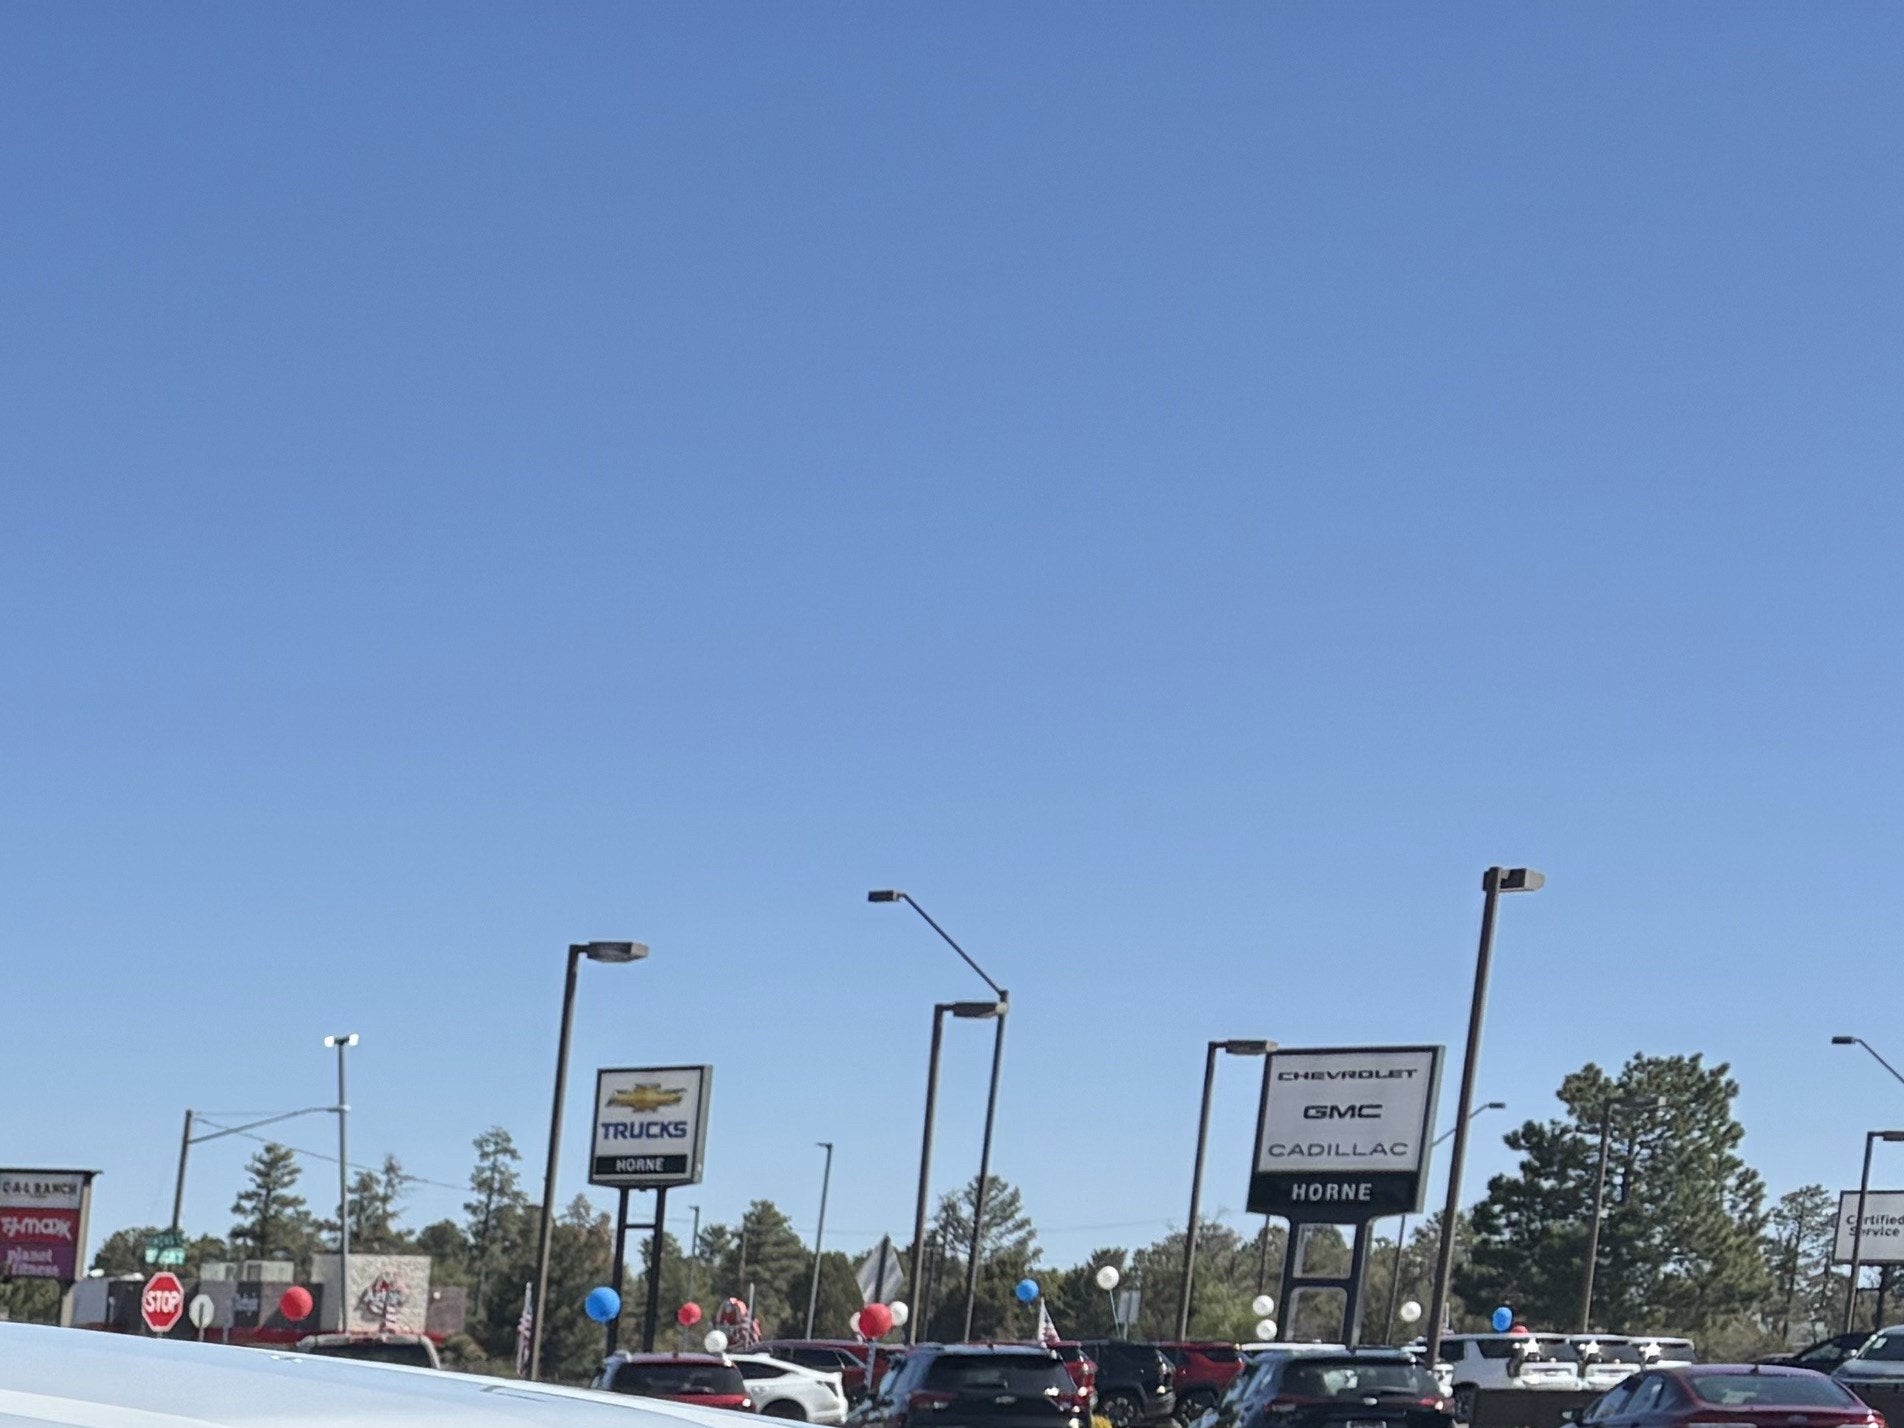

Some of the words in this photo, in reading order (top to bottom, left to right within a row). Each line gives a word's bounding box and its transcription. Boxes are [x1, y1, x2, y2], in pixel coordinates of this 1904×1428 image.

[1277, 1069, 1418, 1082] CHEVROLET
[1303, 1104, 1383, 1120] GMC
[601, 1121, 688, 1140] TRUCKS
[1268, 1143, 1409, 1158] CADILLAC
[615, 1157, 665, 1172] HORNE
[1292, 1183, 1373, 1201] HORNE
[145, 1290, 180, 1313] STOP
